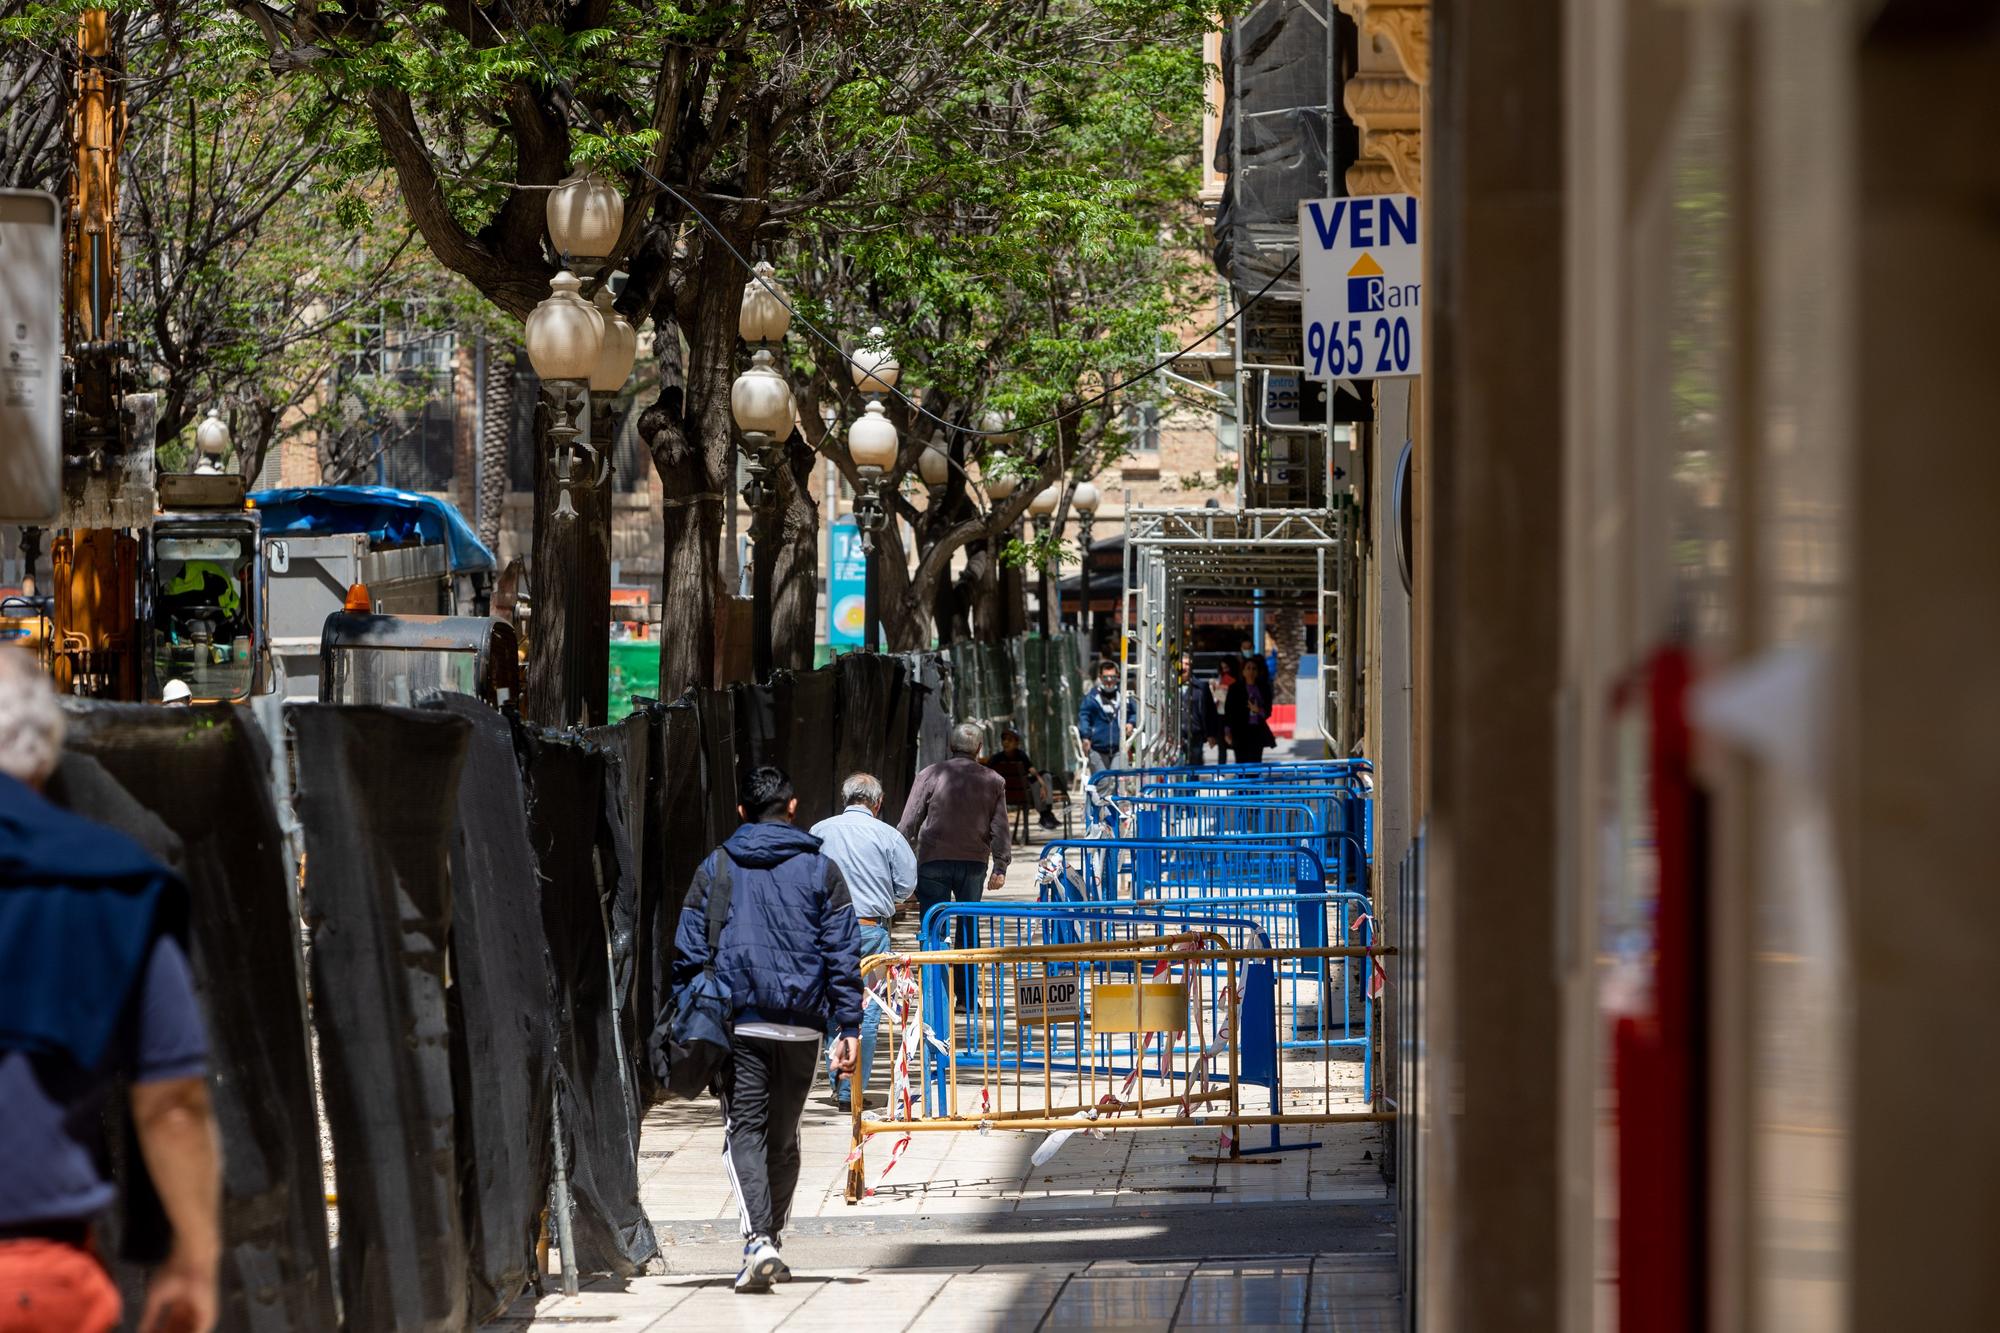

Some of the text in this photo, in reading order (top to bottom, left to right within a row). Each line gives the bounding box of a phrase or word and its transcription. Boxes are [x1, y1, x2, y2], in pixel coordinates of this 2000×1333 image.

[1308, 197, 1417, 250] VEN
[1367, 279, 1421, 309] Ram
[1308, 316, 1410, 376] 965 20
